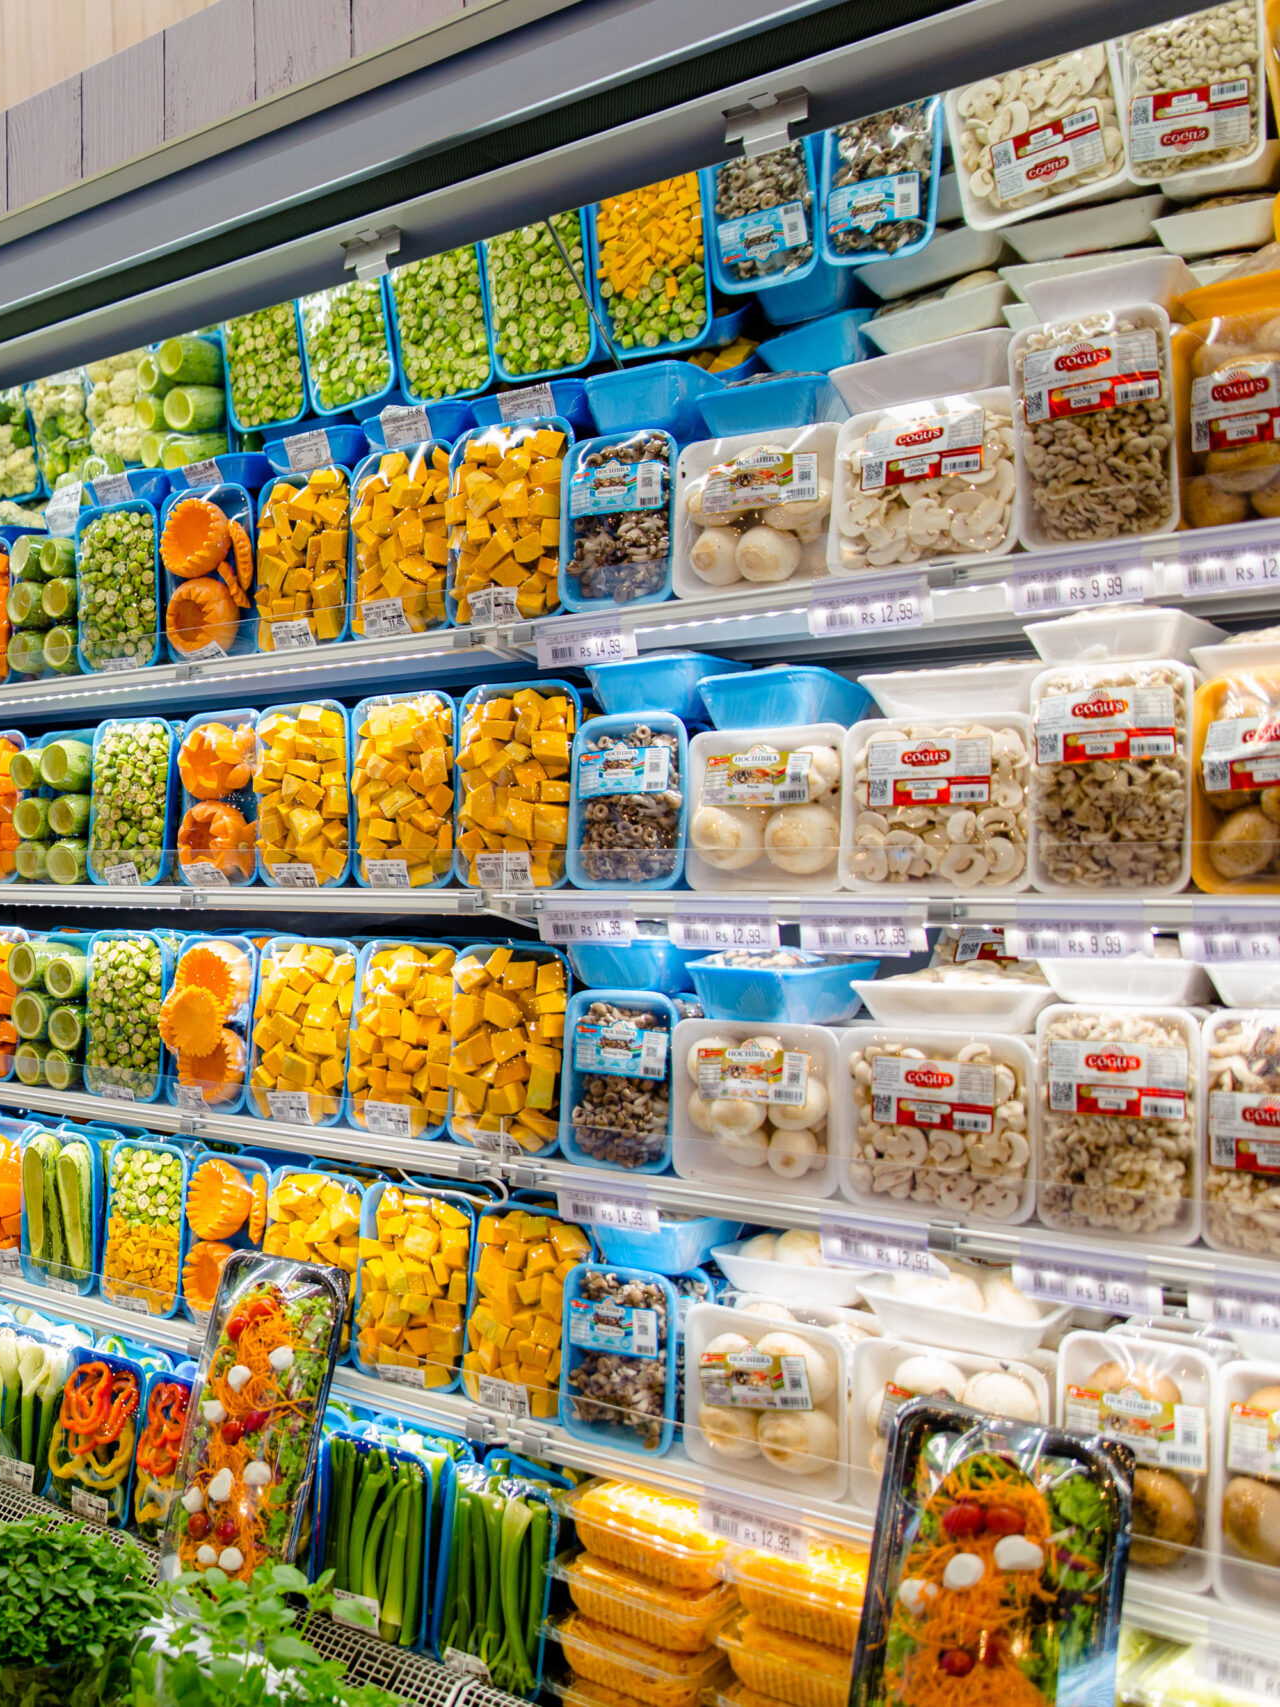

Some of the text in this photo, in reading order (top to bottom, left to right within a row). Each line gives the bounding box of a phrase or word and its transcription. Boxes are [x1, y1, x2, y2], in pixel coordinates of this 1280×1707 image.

[1072, 397, 1092, 406] 200g
[1235, 427, 1256, 437] 200g
[1069, 576, 1123, 600] R$ 9,99
[861, 602, 913, 624] R$ 12,99
[580, 638, 621, 658] R$ 14,99
[580, 920, 622, 937] R$ 14,99
[715, 928, 761, 945] R$ 12,99
[854, 928, 906, 947] R$ 12,99
[1068, 935, 1122, 956] R$ 9,99
[1252, 942, 1270, 956] R$
[601, 1208, 643, 1227] R$ 14,99
[876, 1248, 930, 1272] R$ 12,99
[1075, 1284, 1130, 1306] R$ 9,99
[744, 1528, 791, 1554] R$ 12,99
